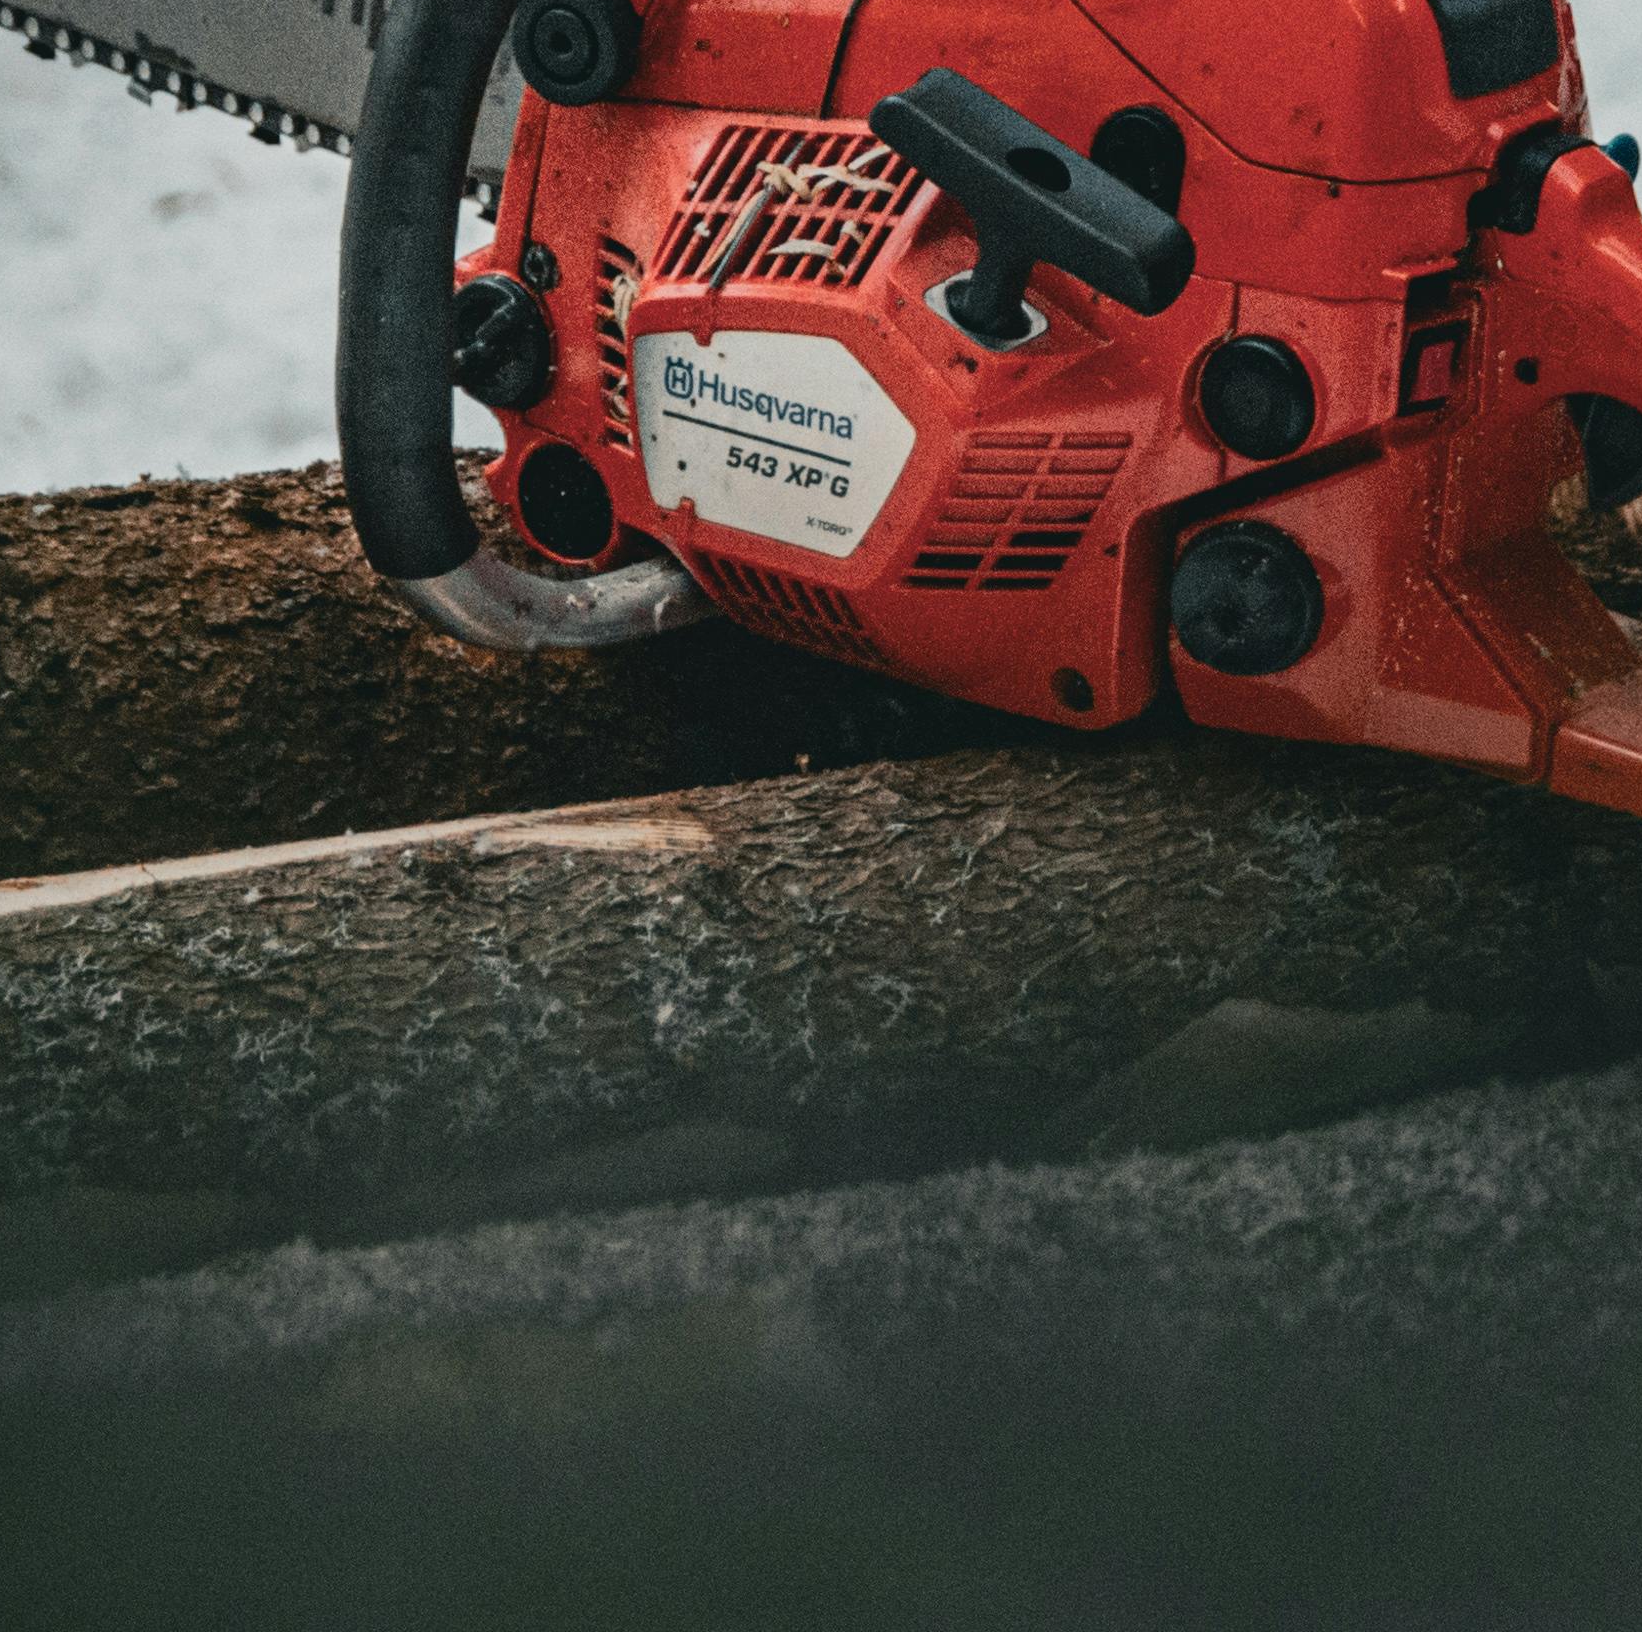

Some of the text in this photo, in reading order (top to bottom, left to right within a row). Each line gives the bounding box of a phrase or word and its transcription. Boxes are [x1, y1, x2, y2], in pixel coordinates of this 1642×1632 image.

[698, 369, 853, 440] Husqvarna
[726, 445, 779, 478] 543
[829, 474, 851, 499] G
